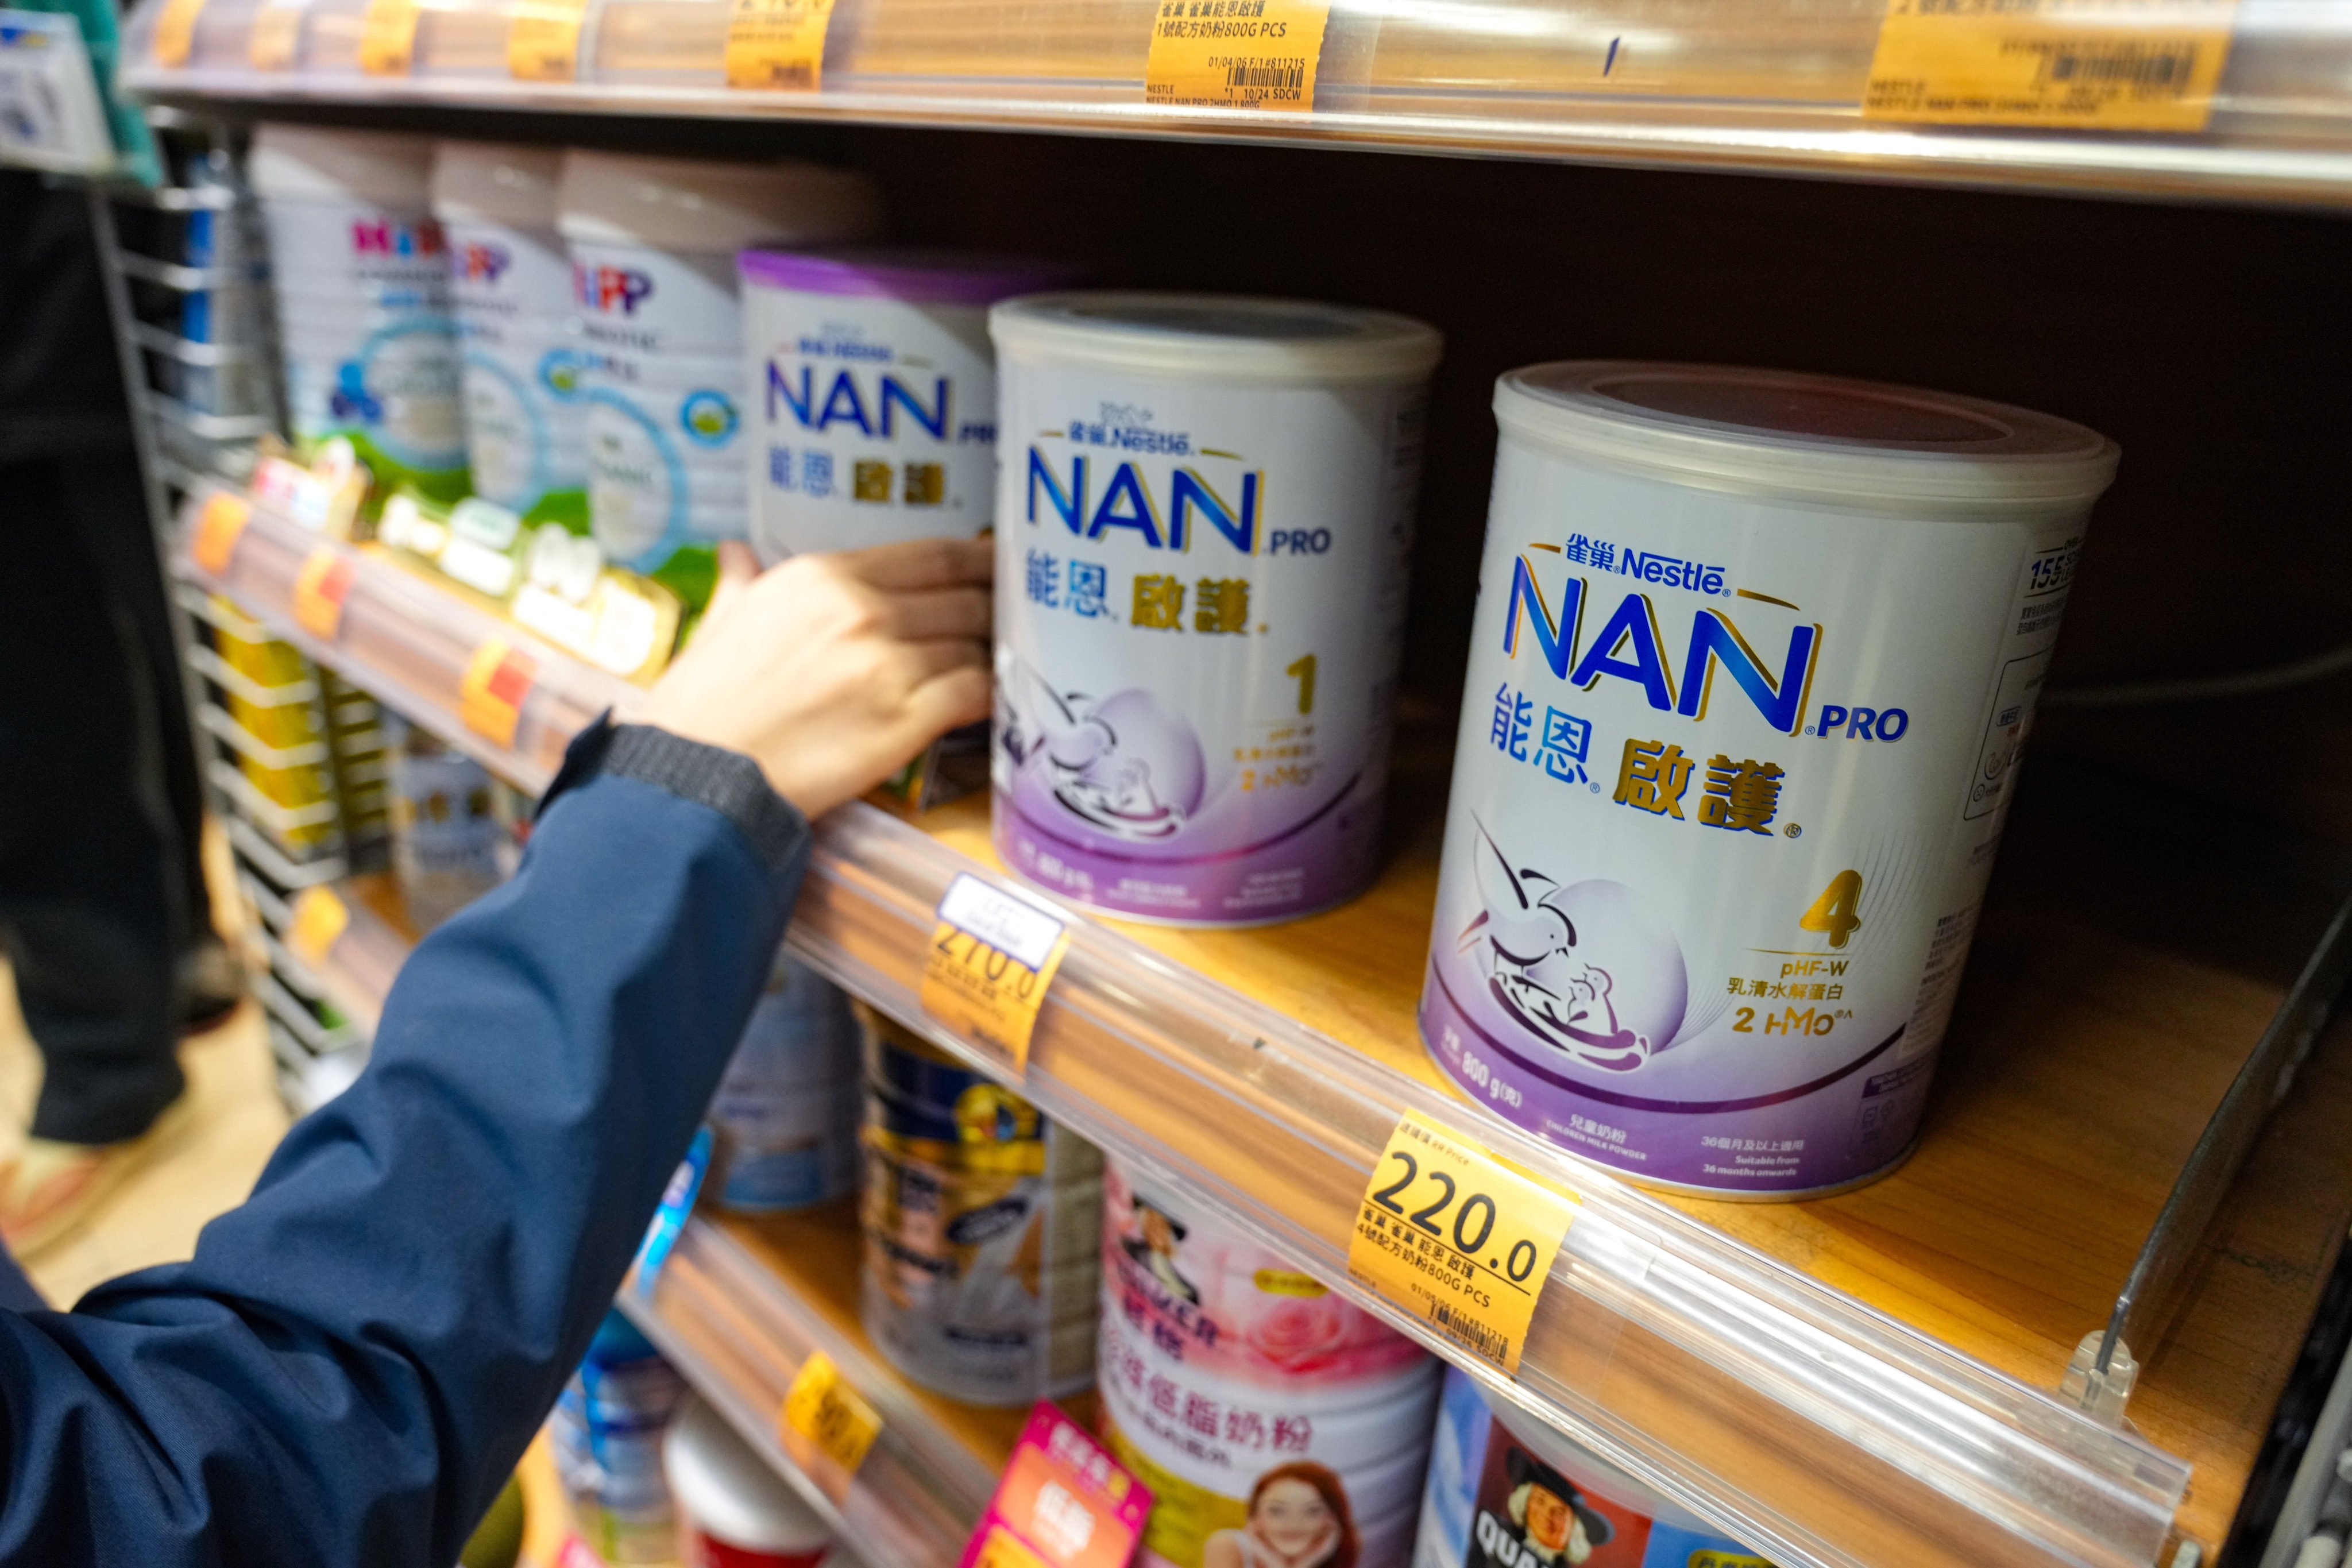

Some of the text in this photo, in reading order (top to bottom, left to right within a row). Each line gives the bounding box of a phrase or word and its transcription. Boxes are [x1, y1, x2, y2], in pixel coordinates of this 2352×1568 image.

[1162, 1, 1184, 17] 雀巢
[1260, 22, 1287, 37] PCS
[1208, 56, 1305, 69] 01/04/06 F/1 #811215
[1146, 96, 1173, 105] NESTLE
[1176, 97, 1191, 105] NAN
[1147, 84, 1174, 94] NESTLE
[1244, 88, 1269, 101] 10/24
[1273, 88, 1301, 101] SDCW
[766, 360, 955, 442] NAN
[1028, 444, 1264, 557] NAN
[1268, 526, 1331, 555] PRO
[1566, 533, 1615, 571] 雀巢
[1026, 549, 1251, 634] 能恩 啟護
[1503, 554, 1823, 737] NAN
[1285, 653, 1317, 715] 1
[1817, 705, 1909, 743] PRO
[1490, 682, 1786, 837] 能恩 啟護
[1799, 869, 1863, 949] 4
[1780, 960, 1849, 979] pHF-W
[1727, 977, 1843, 1001] 乳清水解蛋白
[1733, 1007, 1755, 1033] 2
[1462, 1051, 1490, 1088] 800
[1545, 1119, 1647, 1161] CHILDREN MILK POWDER
[1570, 1113, 1627, 1145] 兒童奶粉
[1432, 1140, 1445, 1152] RR
[1446, 1147, 1470, 1165] Price
[1735, 1155, 1801, 1165] Suitable from
[1702, 1164, 1797, 1176] 36 months onwards
[1372, 1151, 1536, 1282] 220.0
[1364, 1206, 1476, 1280] 雀巢 雀巢 能恩 啟護
[1464, 1284, 1490, 1308] PCS
[1476, 1510, 1551, 1568] QUA
